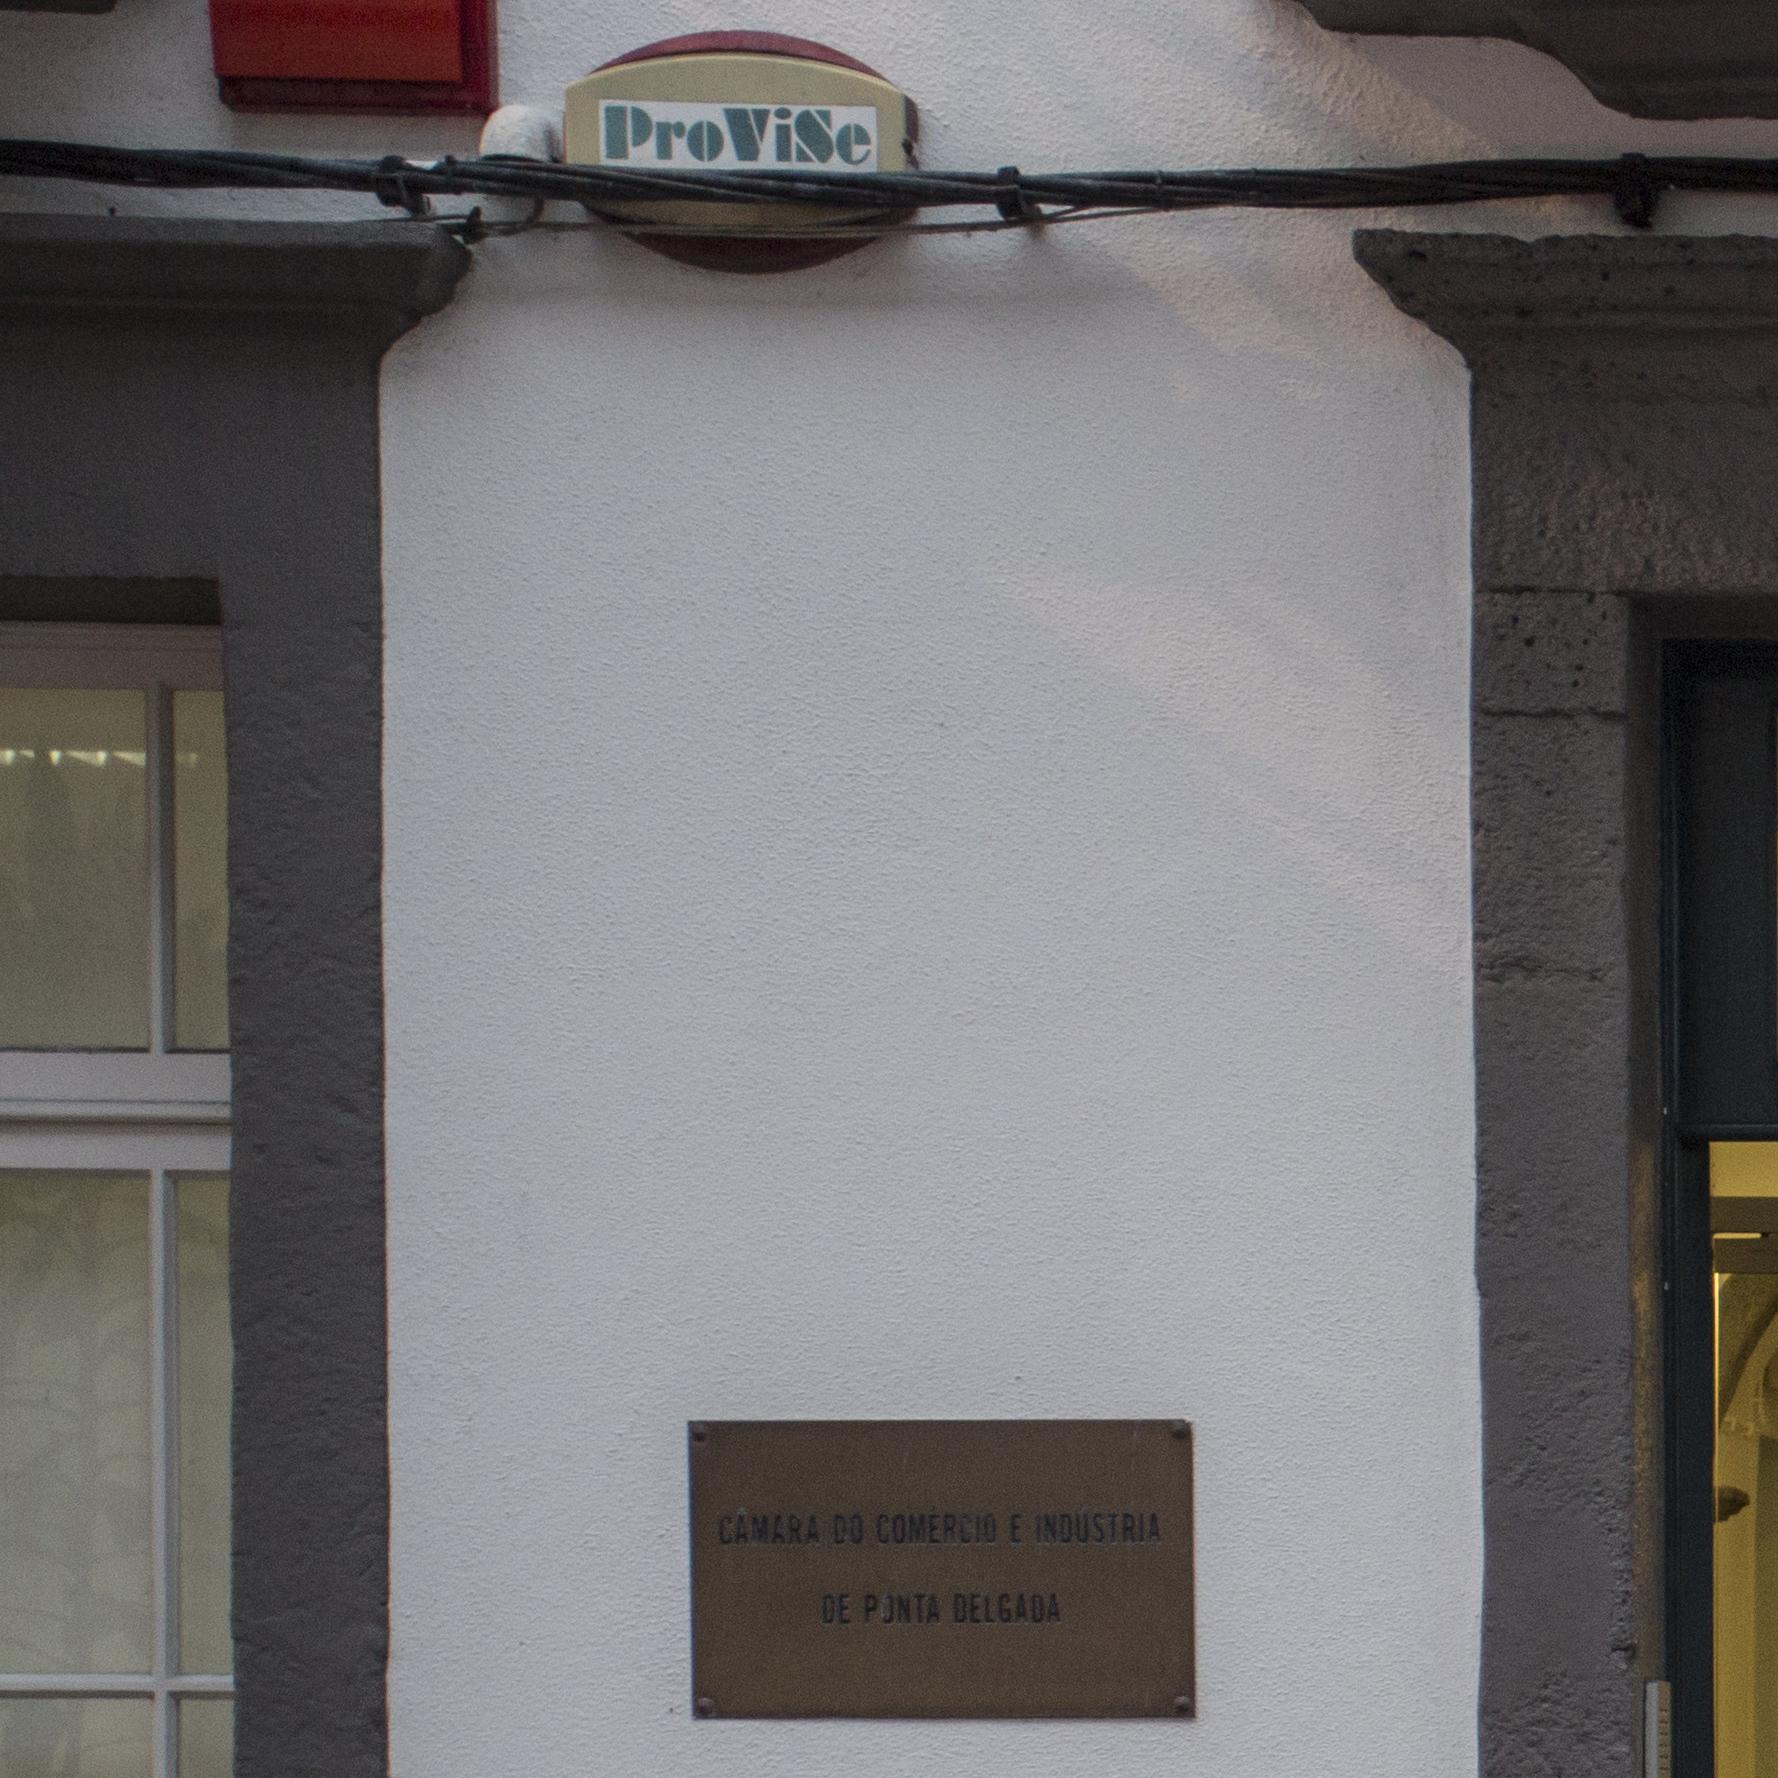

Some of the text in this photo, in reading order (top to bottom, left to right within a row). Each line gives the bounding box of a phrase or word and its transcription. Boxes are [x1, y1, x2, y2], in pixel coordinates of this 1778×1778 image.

[604, 105, 871, 166] ProViSe
[833, 1513, 864, 1544] DO
[1009, 1513, 1022, 1544] E
[822, 1594, 851, 1625] DE
[953, 1594, 1062, 1625] DELGADA
